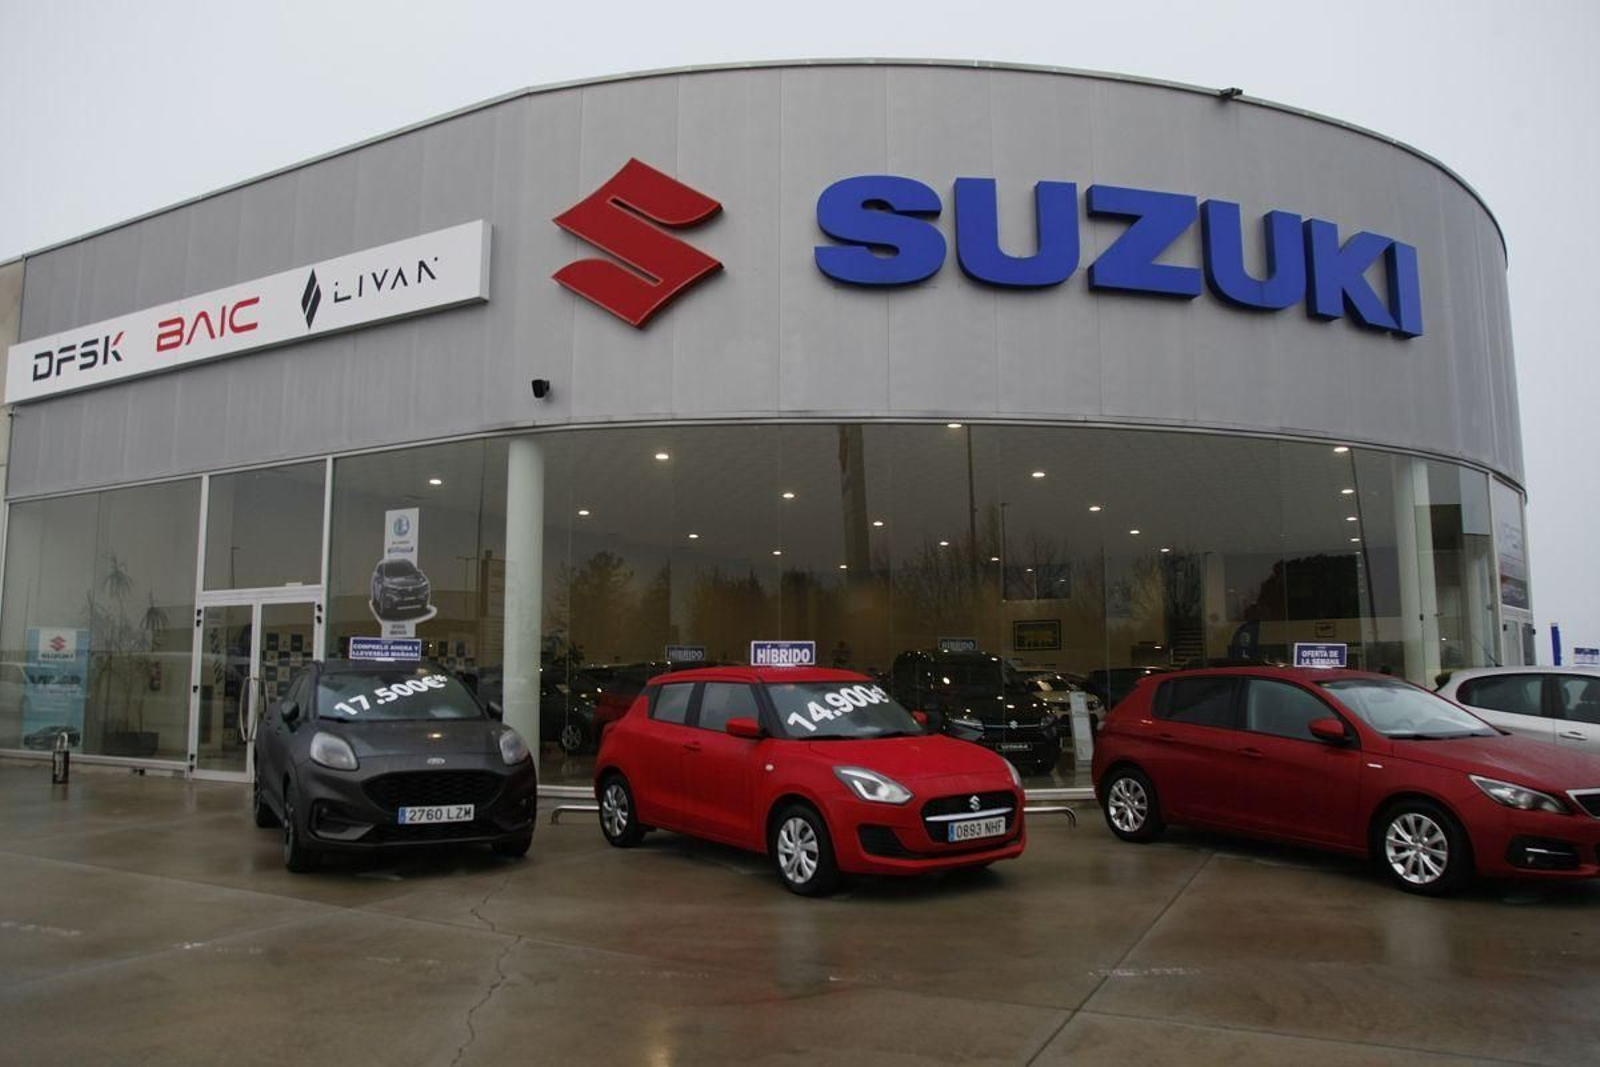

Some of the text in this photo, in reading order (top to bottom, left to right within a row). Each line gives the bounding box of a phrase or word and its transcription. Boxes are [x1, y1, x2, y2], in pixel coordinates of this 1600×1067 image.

[814, 175, 1423, 338] SUZUKI
[334, 257, 438, 303] LIVAN
[156, 296, 260, 352] BAIC
[32, 330, 124, 382] DFSK
[756, 645, 811, 663] HÍBRIDO
[1301, 650, 1340, 658] OFERTA DE
[409, 806, 472, 821] 2760 LZM
[956, 819, 1004, 838] 0893 NHF
